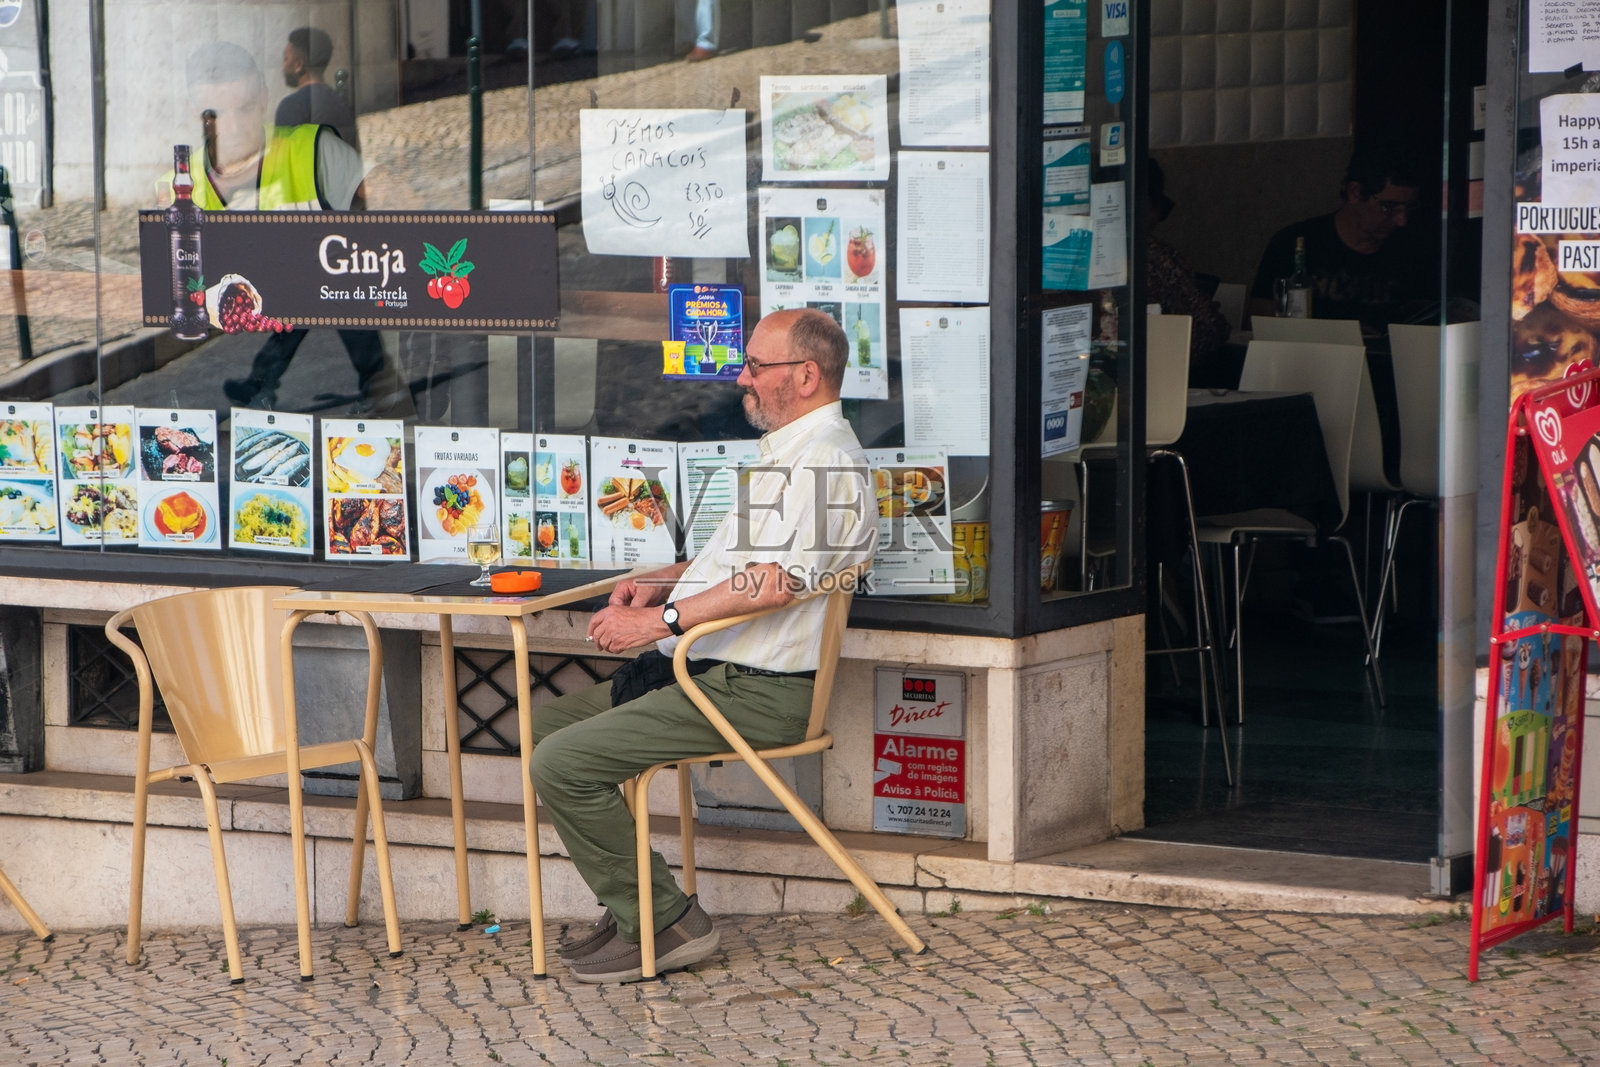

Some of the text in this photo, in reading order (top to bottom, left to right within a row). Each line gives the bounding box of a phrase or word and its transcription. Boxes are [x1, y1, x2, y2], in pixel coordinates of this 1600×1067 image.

[1105, 2, 1127, 19] VISA
[1562, 137, 1588, 150] 15h
[318, 234, 407, 288] Ginja
[320, 285, 408, 300] Serra da Estrela
[385, 300, 408, 309] Portugal
[685, 301, 728, 309] PRÉMIOS A
[685, 309, 728, 317] CADA HORA
[434, 452, 479, 462] FRUTAS VARIADAS
[903, 692, 935, 700] SECURITAS
[888, 701, 953, 728] Direct
[882, 738, 959, 761] Alarme
[907, 762, 958, 774] com registo
[907, 770, 958, 784] de imagens
[882, 783, 912, 795] Aviso
[914, 786, 921, 796] à
[897, 805, 951, 818] 707 24 12 24
[888, 816, 952, 827] www.securitasdirect.pt
